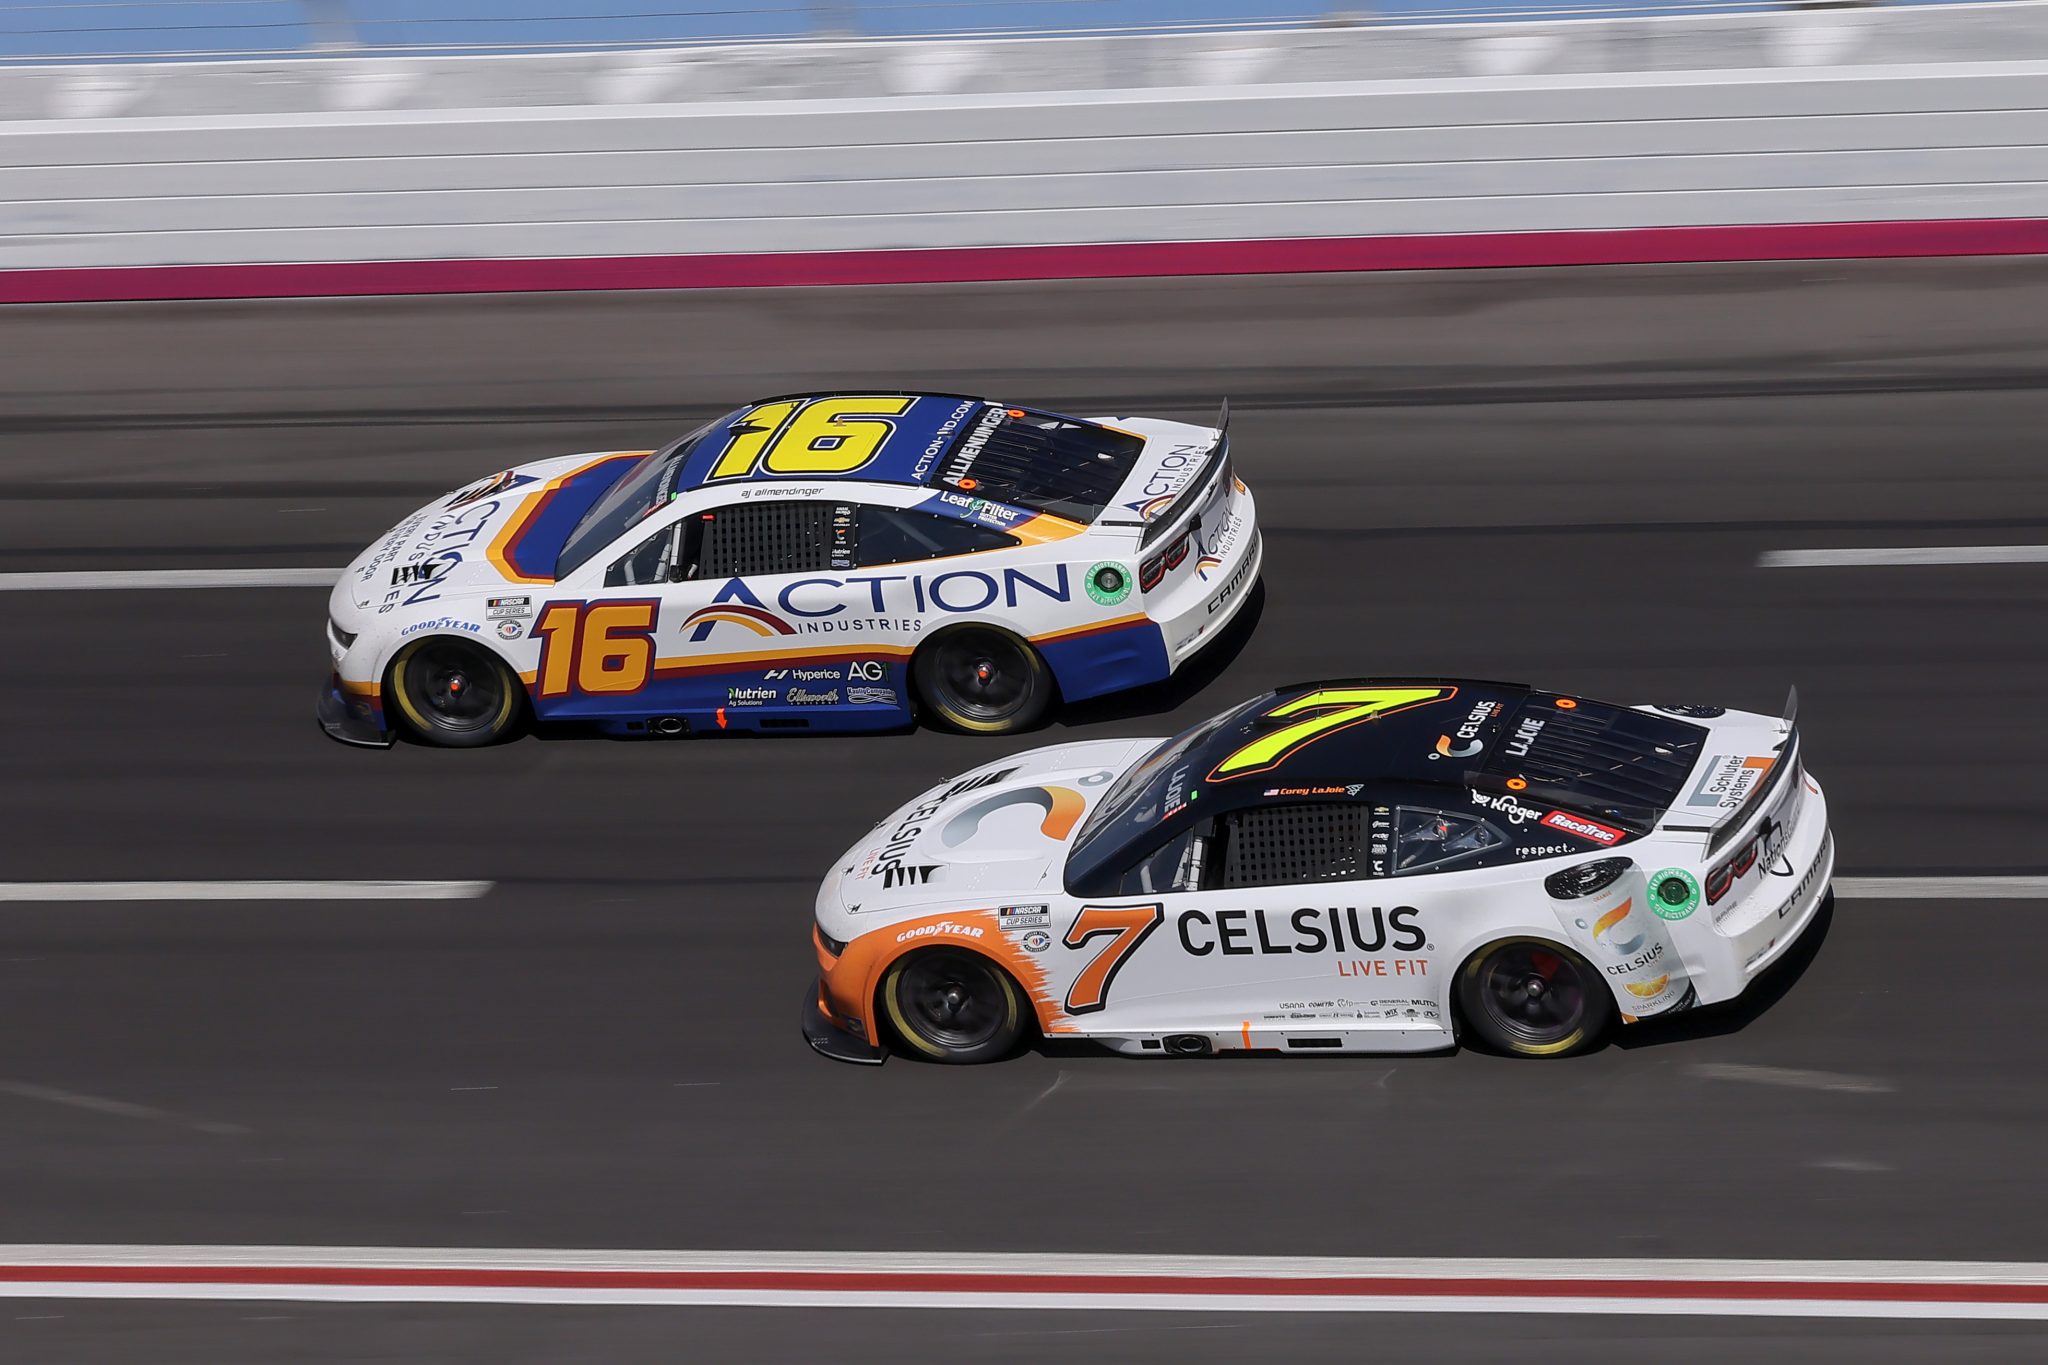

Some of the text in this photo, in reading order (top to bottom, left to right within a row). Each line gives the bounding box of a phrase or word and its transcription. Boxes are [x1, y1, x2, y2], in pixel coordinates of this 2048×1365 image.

[703, 397, 921, 484] 16
[755, 487, 824, 497] allmendinger
[680, 564, 1071, 642] ACTION
[401, 617, 481, 636] GOODYEAR
[798, 619, 922, 634] INDUSTRIES
[528, 597, 662, 701] 16
[793, 669, 841, 681] Hyperice
[728, 687, 777, 700] Nutrien
[728, 700, 737, 708] Ag
[1206, 686, 1459, 782] 7
[1710, 755, 1745, 793] Schluter
[1280, 786, 1346, 796] Corey LaJoie
[1720, 769, 1755, 809] Systems
[1490, 795, 1543, 825] Kroger
[1549, 814, 1616, 842] RaceTrac
[1006, 916, 1043, 925] CUP SERIES
[1014, 906, 1041, 915] NASCAR
[896, 921, 984, 943] GOODYEAR
[1177, 906, 1427, 957] CELSIUS
[1062, 902, 1165, 1017] 7
[1337, 959, 1429, 977] LIVE FIT
[1607, 942, 1664, 976] CELSIUS
[1279, 1002, 1305, 1010] USANA
[1384, 1008, 1398, 1016] WIX
